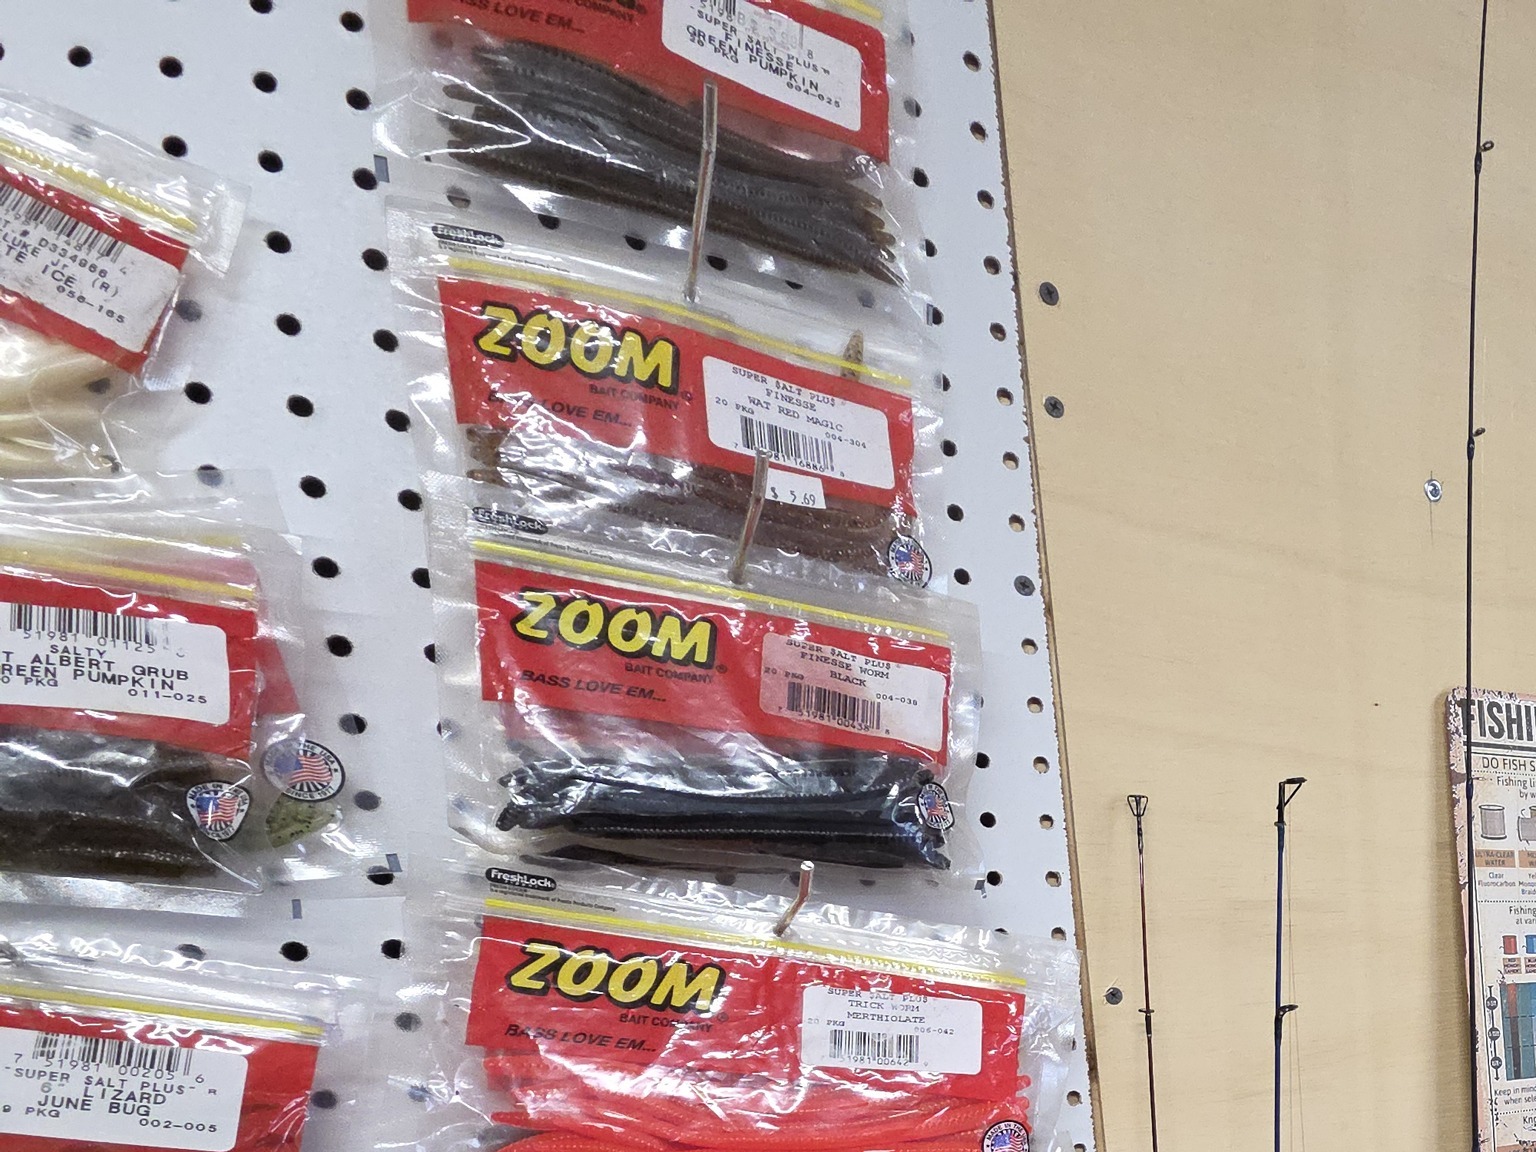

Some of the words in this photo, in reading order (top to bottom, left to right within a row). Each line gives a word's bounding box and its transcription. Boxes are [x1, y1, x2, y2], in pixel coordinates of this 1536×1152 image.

[493, 4, 542, 23] LOVE
[686, 24, 739, 56] GREEN
[749, 56, 819, 91] PUMPKIN
[725, 34, 794, 70] FINESSE
[786, 81, 841, 108] 004-025
[41, 265, 77, 288] ICE
[475, 302, 680, 394] ZOOM
[732, 366, 768, 385] SUPER
[590, 385, 618, 397] BAIT
[620, 389, 680, 410] COMPANY
[766, 388, 817, 412] FINESSE
[748, 396, 772, 411] WAT
[778, 405, 800, 419] RED
[806, 414, 843, 433] MAGIC
[510, 586, 717, 669] ZOOM
[50, 644, 107, 660] SALTY
[785, 638, 823, 654] SUPER
[30, 653, 116, 673] ALBERT
[131, 665, 190, 682] GRUB
[625, 662, 652, 675] BAIT
[655, 667, 715, 684] COMPANY
[800, 651, 852, 672] FINESSE
[859, 666, 890, 679] WORM
[72, 668, 175, 691] PUMPKIN
[520, 669, 570, 689] BASS
[574, 678, 624, 694] LOVE
[829, 670, 867, 687] BLACK
[24, 677, 59, 688] PKG
[127, 687, 208, 705] 011-025
[1482, 757, 1499, 769] DO
[1503, 759, 1526, 771] FISH
[1497, 776, 1527, 789] Fishing
[1519, 790, 1529, 799] by
[490, 869, 552, 888] FreshLock
[506, 939, 728, 1016] ZOOM
[827, 988, 862, 999] SUPER
[848, 1000, 884, 1011] TRICK
[619, 1013, 648, 1025] BAIT
[846, 1011, 926, 1024] MERTHIOLATE
[505, 1024, 558, 1040] BASS
[560, 1032, 614, 1048] LOVE
[84, 1075, 128, 1089] SALT
[1494, 1088, 1511, 1096] Keep
[37, 1094, 93, 1112] JUNE
[108, 1102, 151, 1118] BUG
[83, 1085, 167, 1106] LIZARD
[24, 1106, 61, 1119] PKG
[139, 1118, 218, 1133] 002-005
